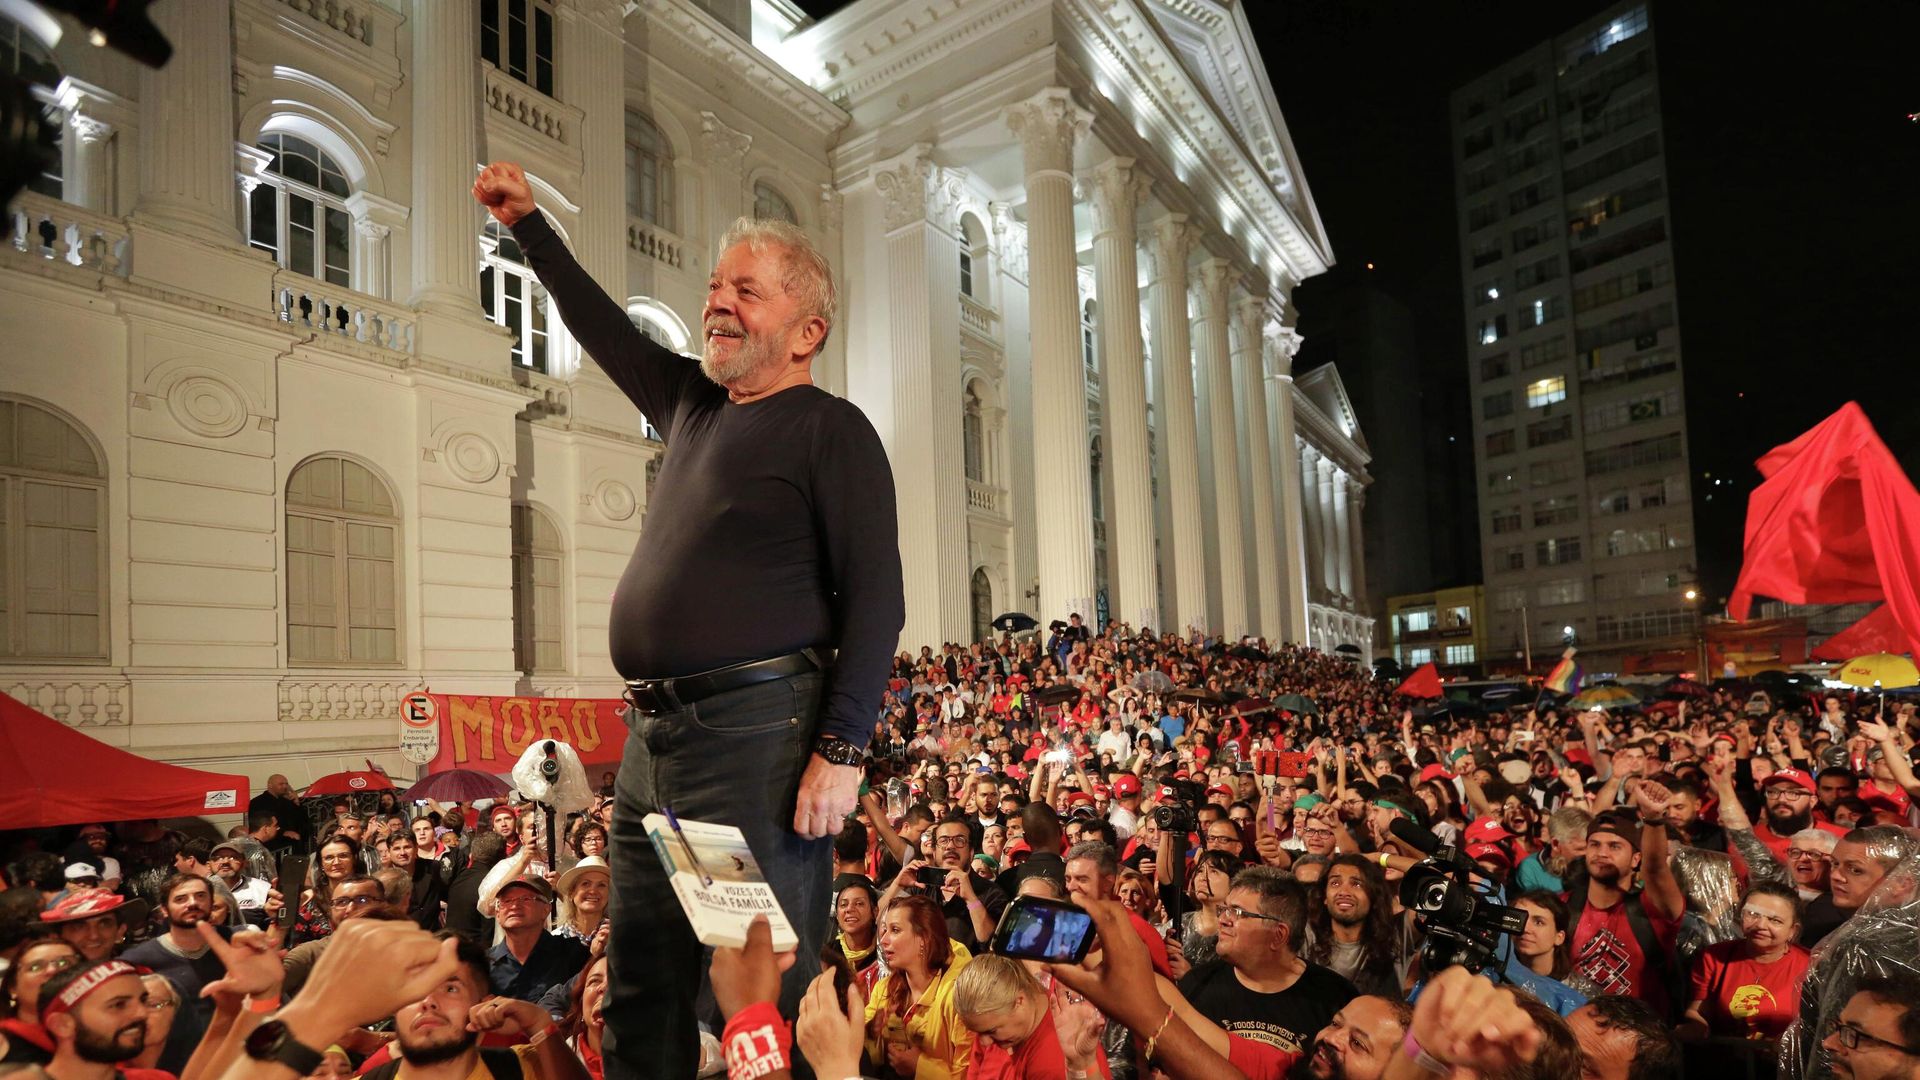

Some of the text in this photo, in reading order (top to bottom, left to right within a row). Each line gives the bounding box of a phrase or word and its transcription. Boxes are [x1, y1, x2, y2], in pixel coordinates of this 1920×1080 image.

[410, 698, 427, 720] E
[693, 889, 728, 907] BOLSA
[729, 896, 775, 910] FAMÍLIA
[724, 886, 768, 897] VOZES DO
[1233, 1021, 1295, 1040] TODOS OS HOMENS
[1253, 1033, 1273, 1041] CRIADOS
